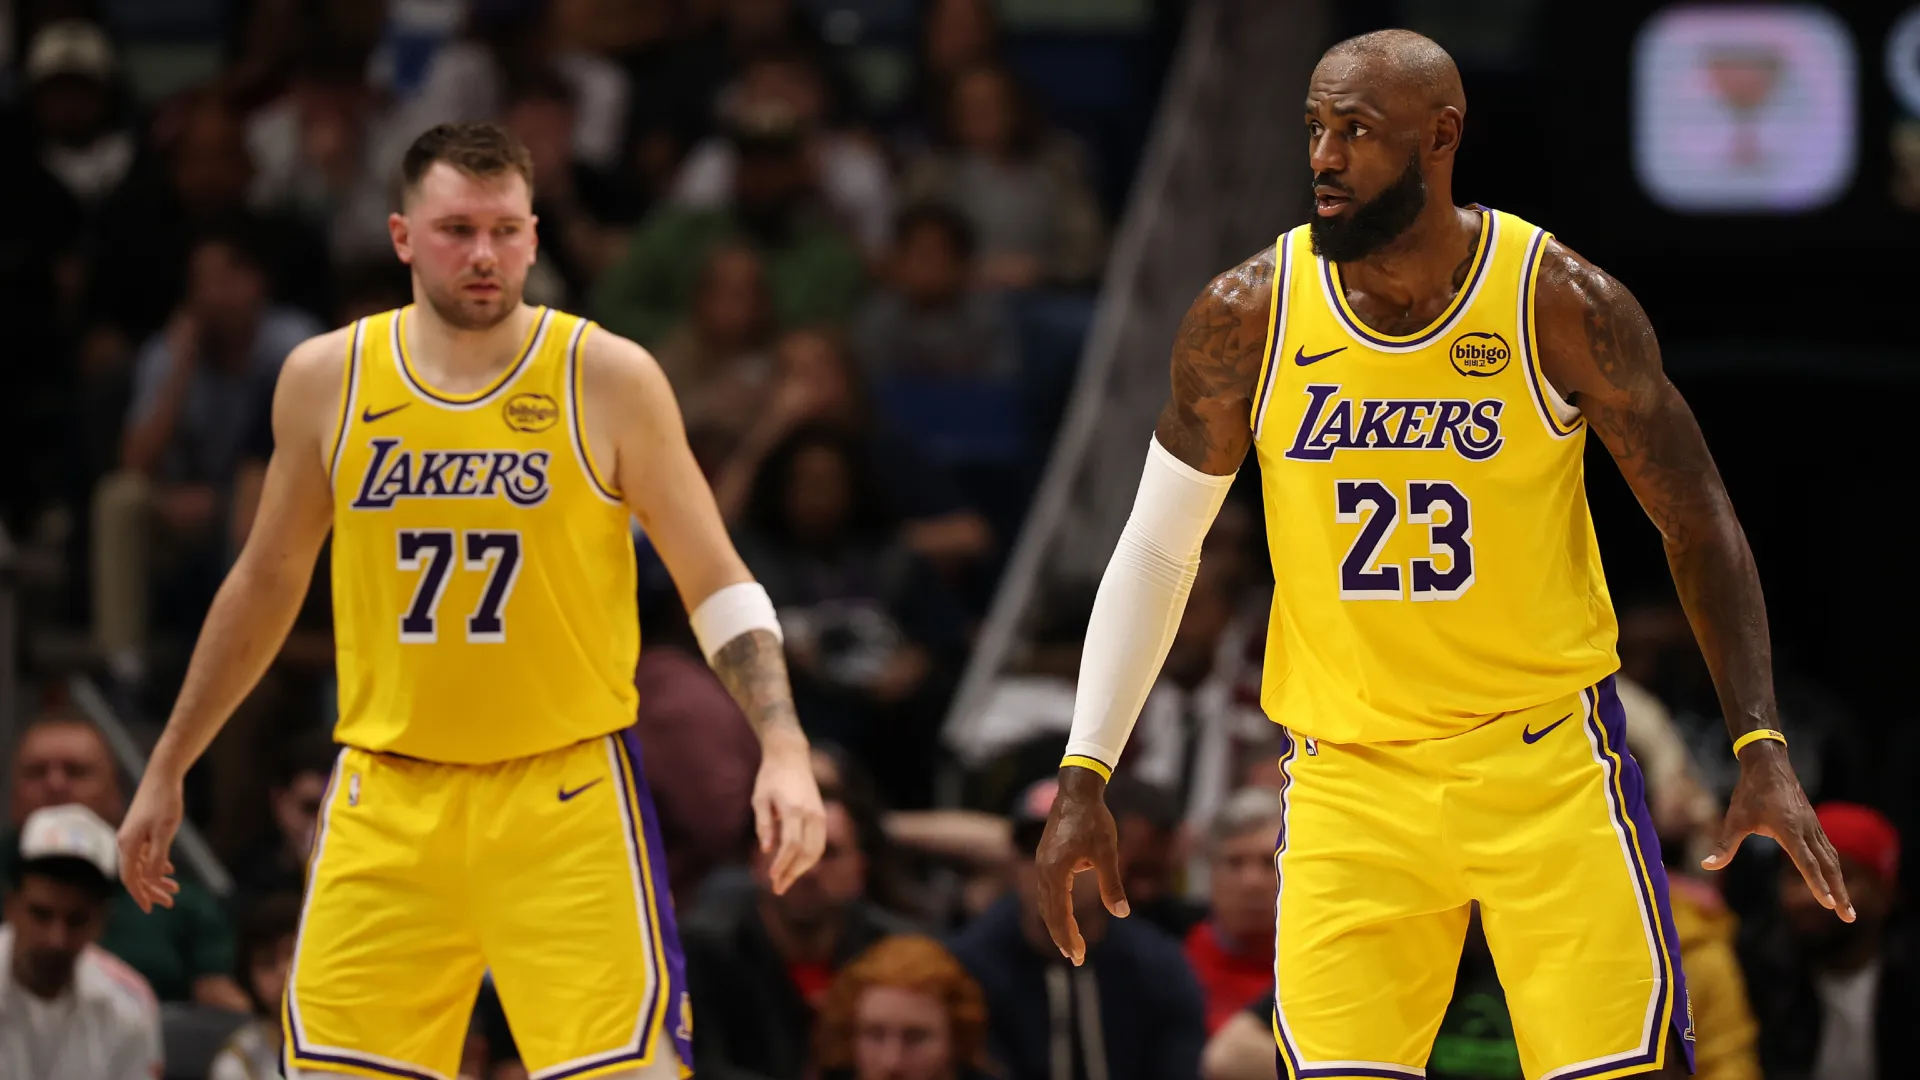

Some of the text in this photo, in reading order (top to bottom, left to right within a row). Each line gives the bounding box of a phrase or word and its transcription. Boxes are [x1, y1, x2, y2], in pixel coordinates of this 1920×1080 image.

[1455, 343, 1507, 364] bibigo
[1464, 359, 1486, 367] 비비고
[1284, 383, 1506, 463] LAKERS
[350, 437, 552, 510] LAKERS
[1334, 479, 1476, 602] 23
[396, 529, 523, 644] 77
